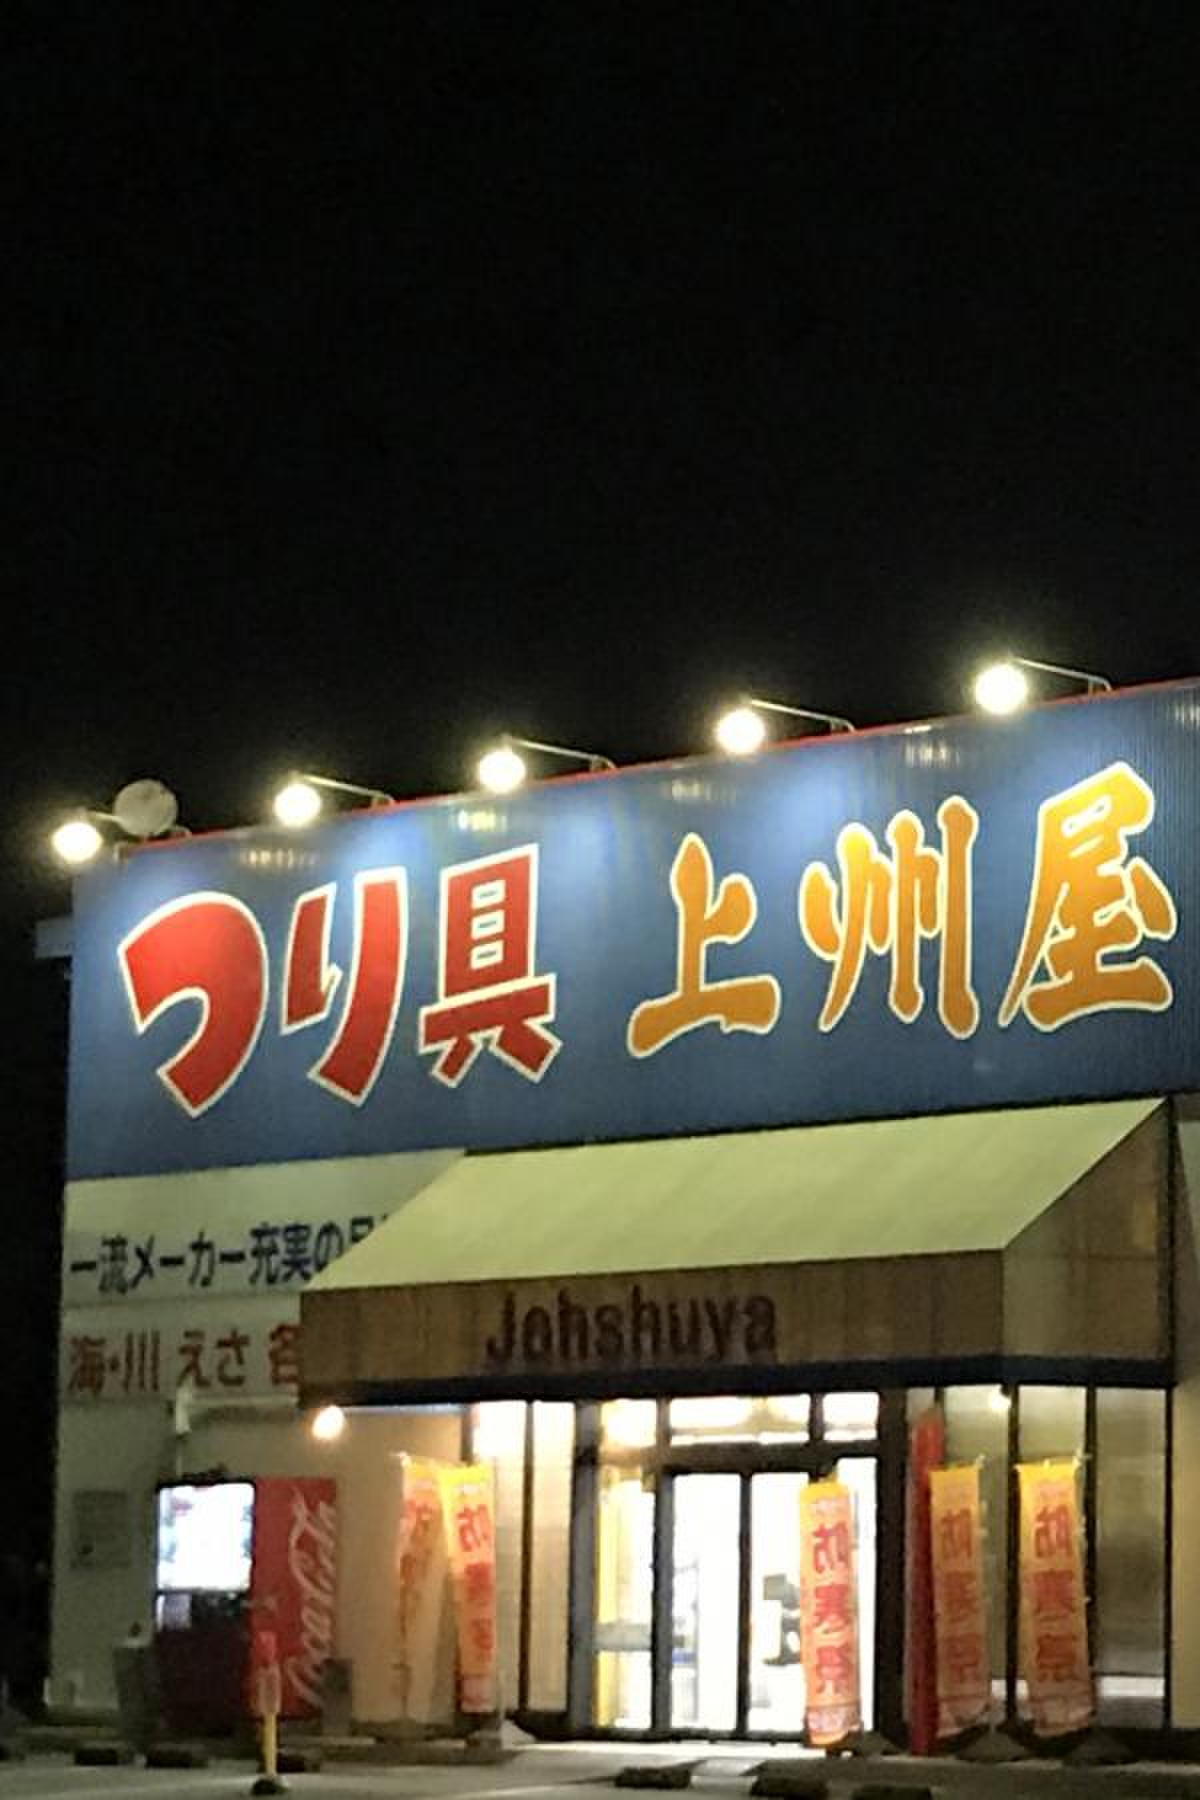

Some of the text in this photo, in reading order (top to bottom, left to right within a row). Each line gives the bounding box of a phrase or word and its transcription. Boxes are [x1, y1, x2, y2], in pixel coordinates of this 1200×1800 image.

[118, 761, 1178, 1118] つり具 上州屋
[70, 1213, 388, 1294] 一流メーカー充実の
[485, 1283, 778, 1364] Johshuya
